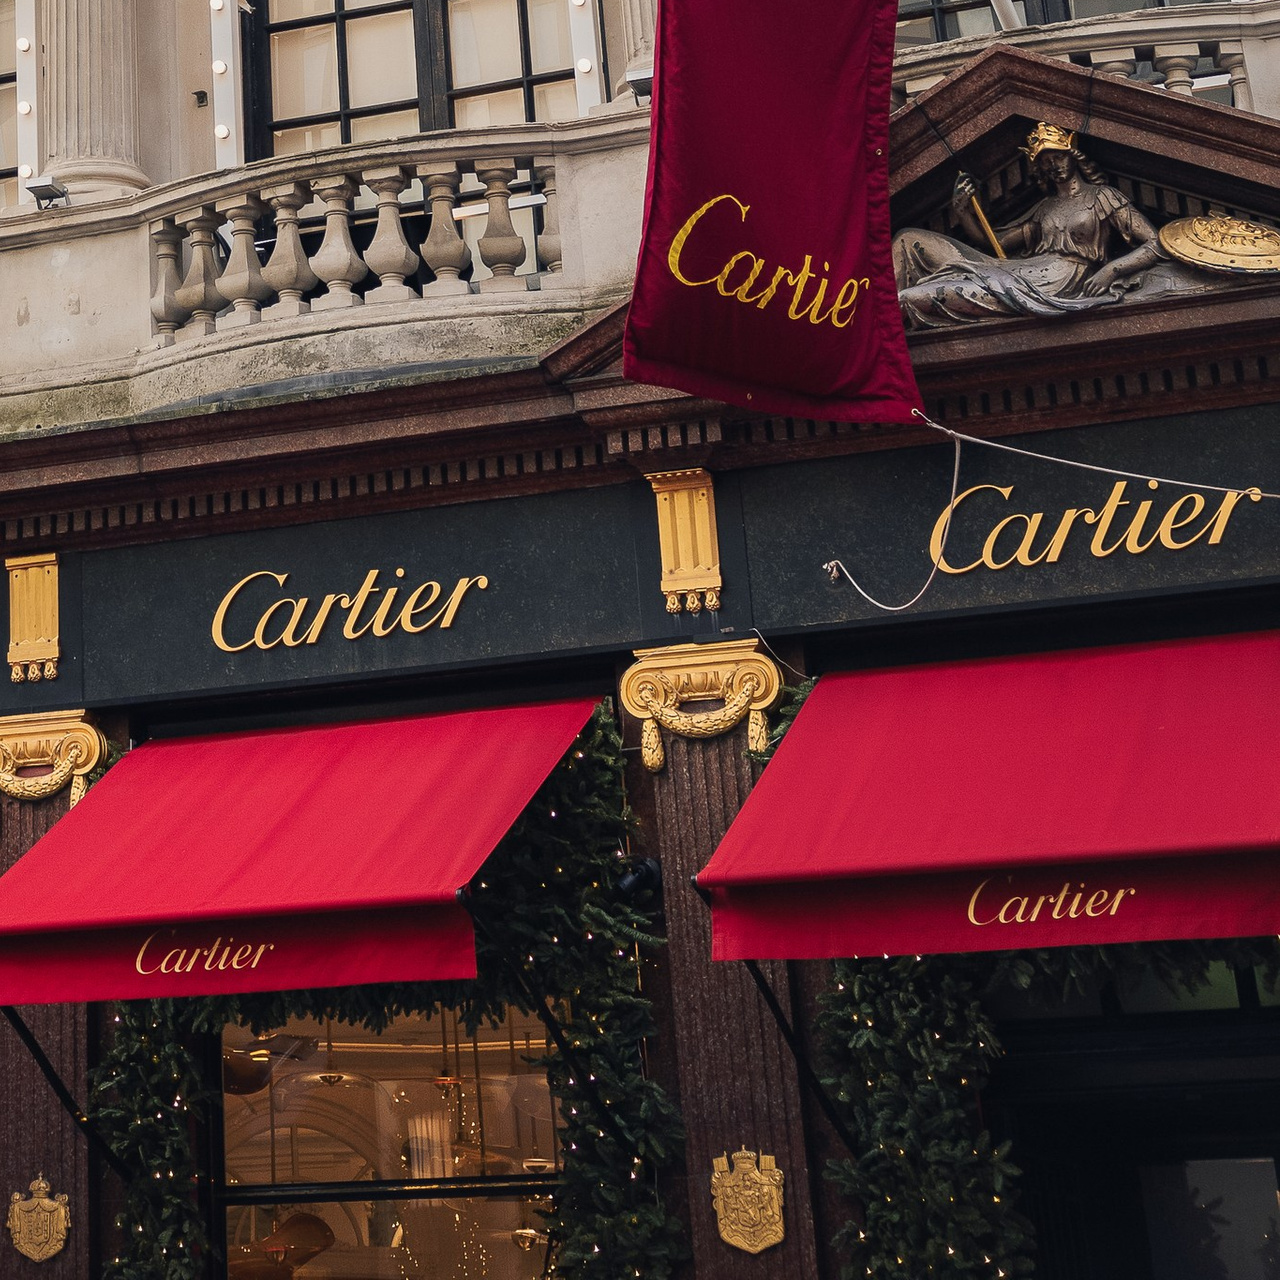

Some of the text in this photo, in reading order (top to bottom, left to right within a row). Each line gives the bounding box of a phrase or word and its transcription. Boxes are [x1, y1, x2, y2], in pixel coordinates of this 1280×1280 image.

[929, 478, 1263, 575] Cartier
[211, 567, 489, 652] Cartier
[967, 876, 1136, 926] Cartier
[135, 929, 275, 975] Cartier
